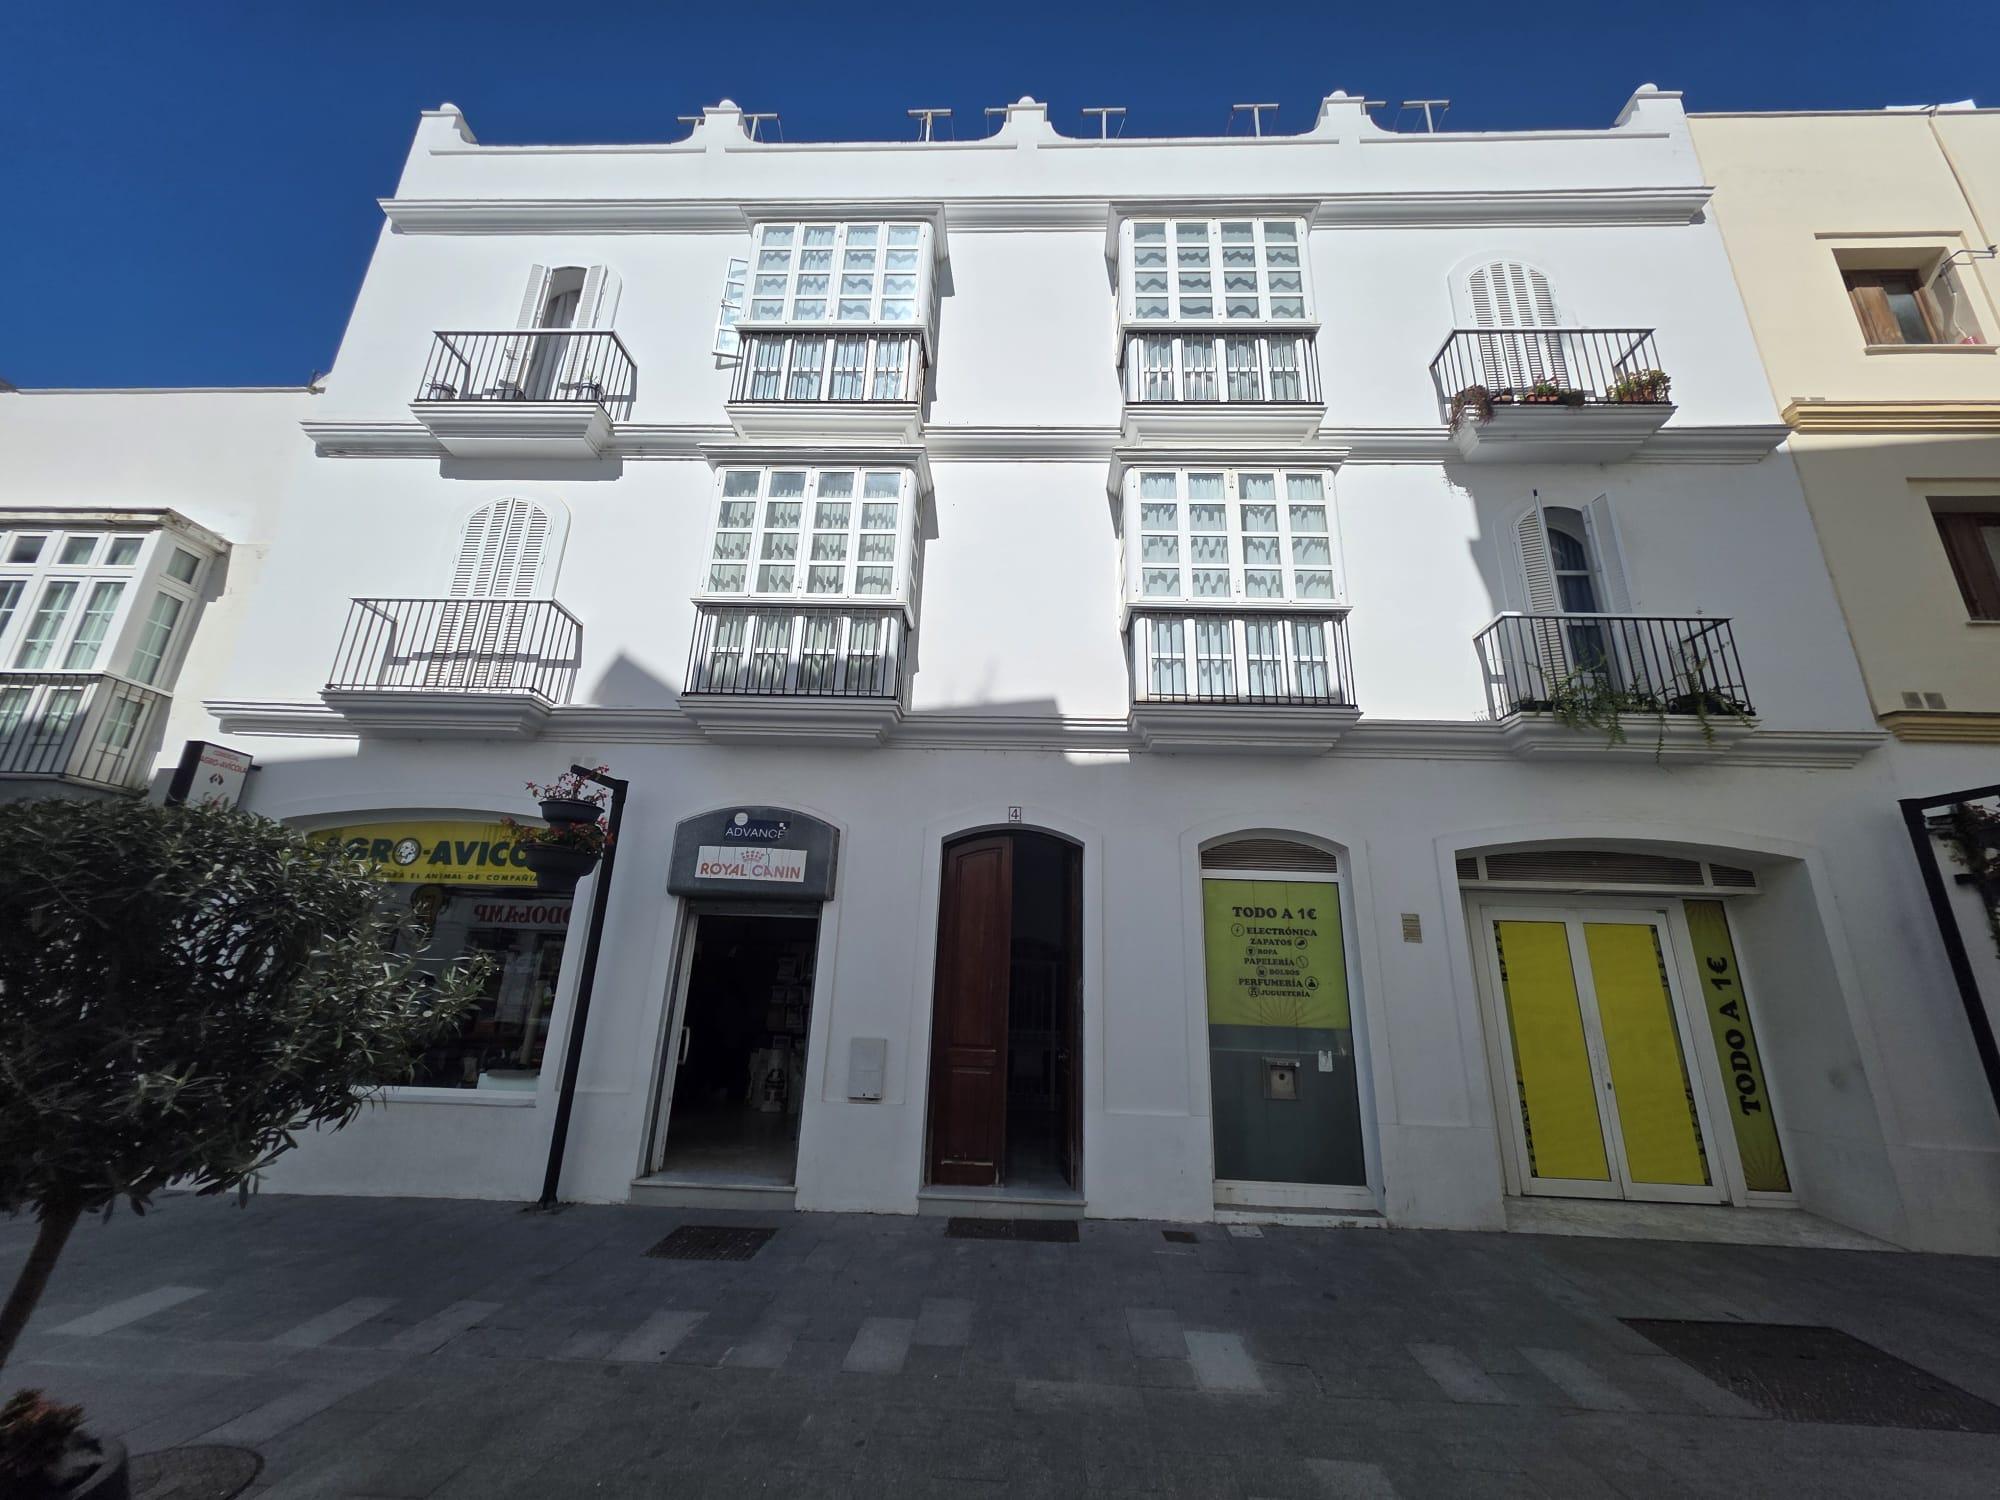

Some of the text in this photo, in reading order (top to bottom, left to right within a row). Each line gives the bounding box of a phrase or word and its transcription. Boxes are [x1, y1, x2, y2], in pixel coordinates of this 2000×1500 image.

[1011, 808, 1020, 819] 4
[725, 827, 785, 839] ADVANCE
[316, 836, 528, 867] GRO-AVICO
[700, 862, 801, 879] ROYAL CANIN
[424, 872, 462, 880] ANIMAL
[467, 873, 481, 881] DE
[1232, 906, 1317, 920] TODO A 1€
[1247, 925, 1318, 937] ELECTRÓNICA
[1250, 937, 1292, 946] ZAPATOS
[1244, 957, 1295, 966] PAPELERÍA
[1268, 968, 1300, 976] BOLSOS
[1239, 977, 1303, 988] PERFUMERÍA
[1261, 989, 1311, 998] JUGUETERÍA
[1707, 955, 1761, 1116] TODO A 1€
